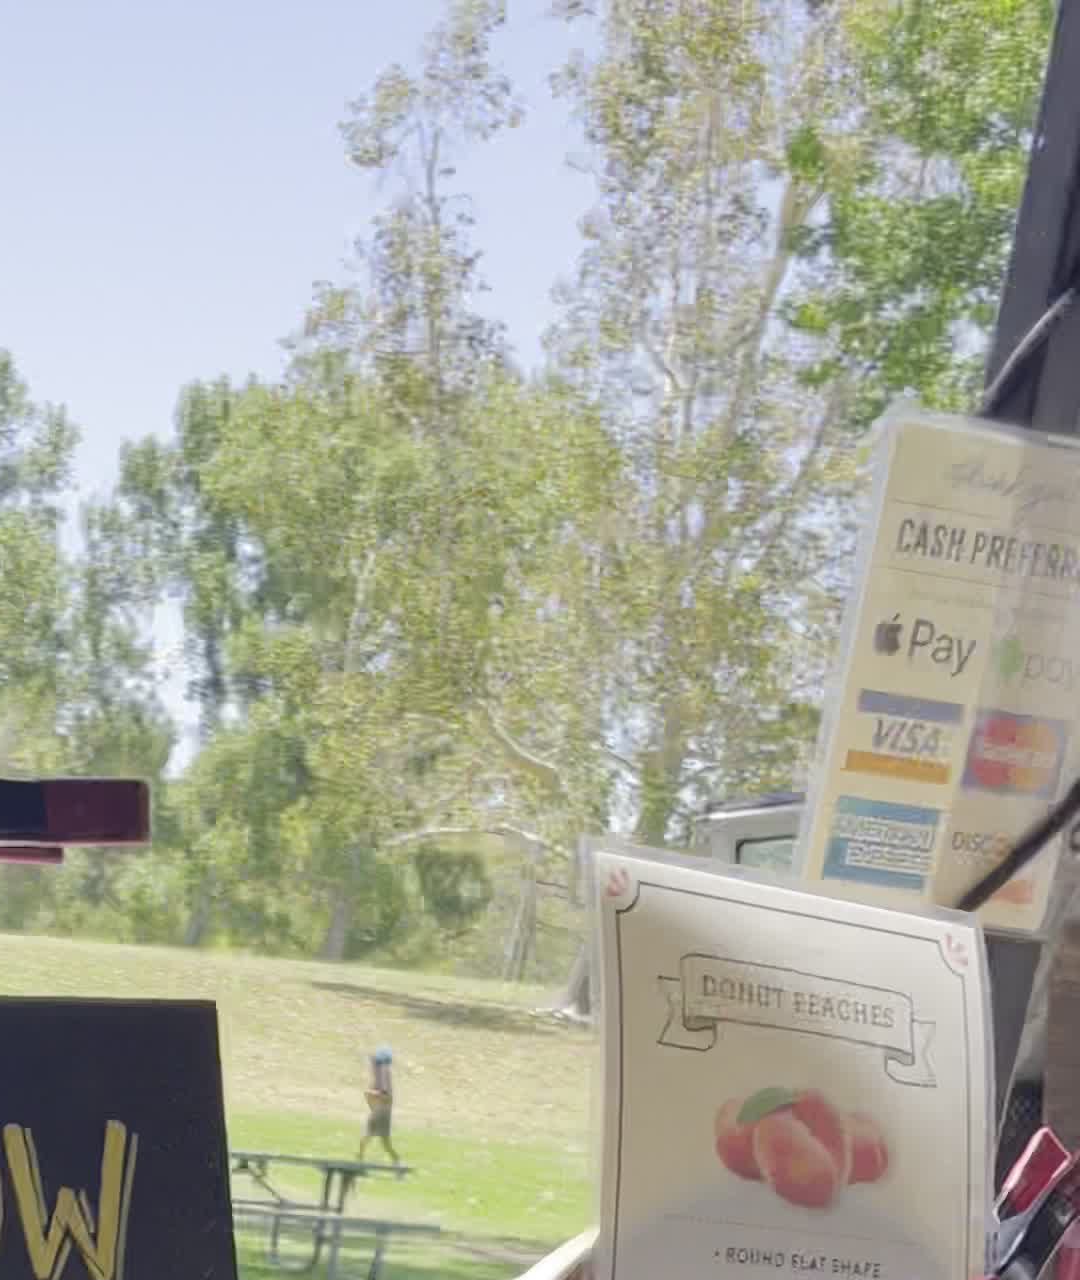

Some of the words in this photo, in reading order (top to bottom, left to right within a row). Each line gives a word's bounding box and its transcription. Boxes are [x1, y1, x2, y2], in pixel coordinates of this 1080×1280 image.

[896, 518, 966, 562] CASH
[907, 617, 976, 678] Pay
[871, 718, 942, 756] VISA
[702, 974, 785, 1008] DONUT
[792, 990, 895, 1029] PEACHES
[725, 1247, 785, 1268] ROUND
[831, 1257, 881, 1279] SHAPE
